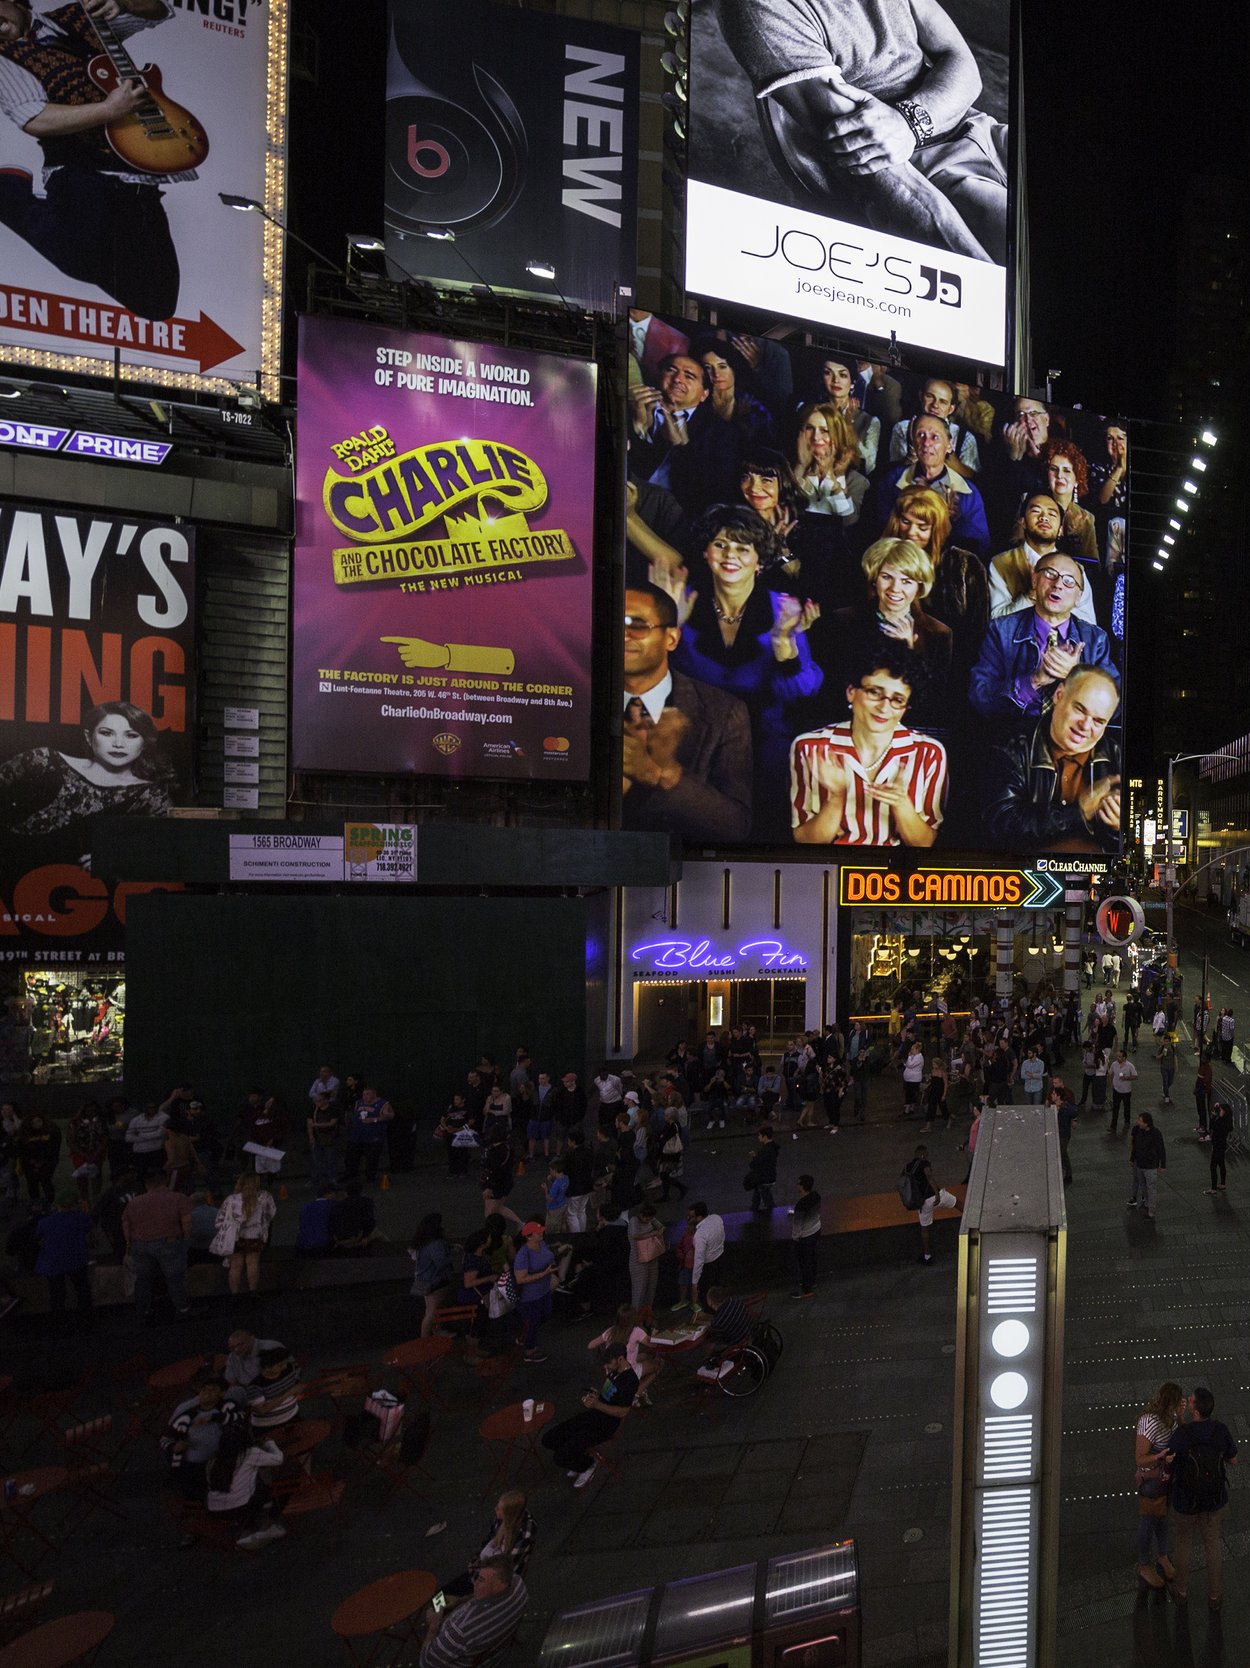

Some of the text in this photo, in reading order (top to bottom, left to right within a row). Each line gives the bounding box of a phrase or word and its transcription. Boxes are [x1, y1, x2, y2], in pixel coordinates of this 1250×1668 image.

[203, 19, 245, 39] REUTERS
[562, 45, 625, 228] NEW
[796, 277, 912, 318] joesjeans.com
[59, 302, 186, 351] THEATRE
[376, 347, 530, 386] STEP INSIDE A WORLD
[375, 368, 535, 408] OF PURE IMAGINATION.
[221, 410, 252, 425] TS-7022
[78, 435, 164, 461] PRIME
[330, 426, 388, 459] ROALD
[330, 445, 535, 533] CHARLIE
[340, 553, 362, 566] AND
[365, 533, 566, 575] CHOCOLATE FACTORY
[342, 565, 364, 577] THE
[400, 570, 523, 594] THE NEW MUSICAL
[318, 669, 573, 696] THE FACTORY IS JUST AROUND THE CORNER
[333, 684, 382, 696] Lunt-Fontanne
[383, 686, 411, 697] Theatre,
[496, 695, 529, 706] Broadway
[530, 697, 542, 706] and
[544, 698, 555, 706] 8th
[381, 705, 513, 725] CharlieOnBroadway.com
[252, 836, 321, 849] 1565 BROADWAY
[351, 828, 412, 841] SPRING
[848, 873, 1020, 901] DOS CAMINOS
[1109, 910, 1120, 933] W
[34, 951, 83, 963] STREET
[88, 953, 101, 963] AT
[632, 940, 807, 968] Blue Fin
